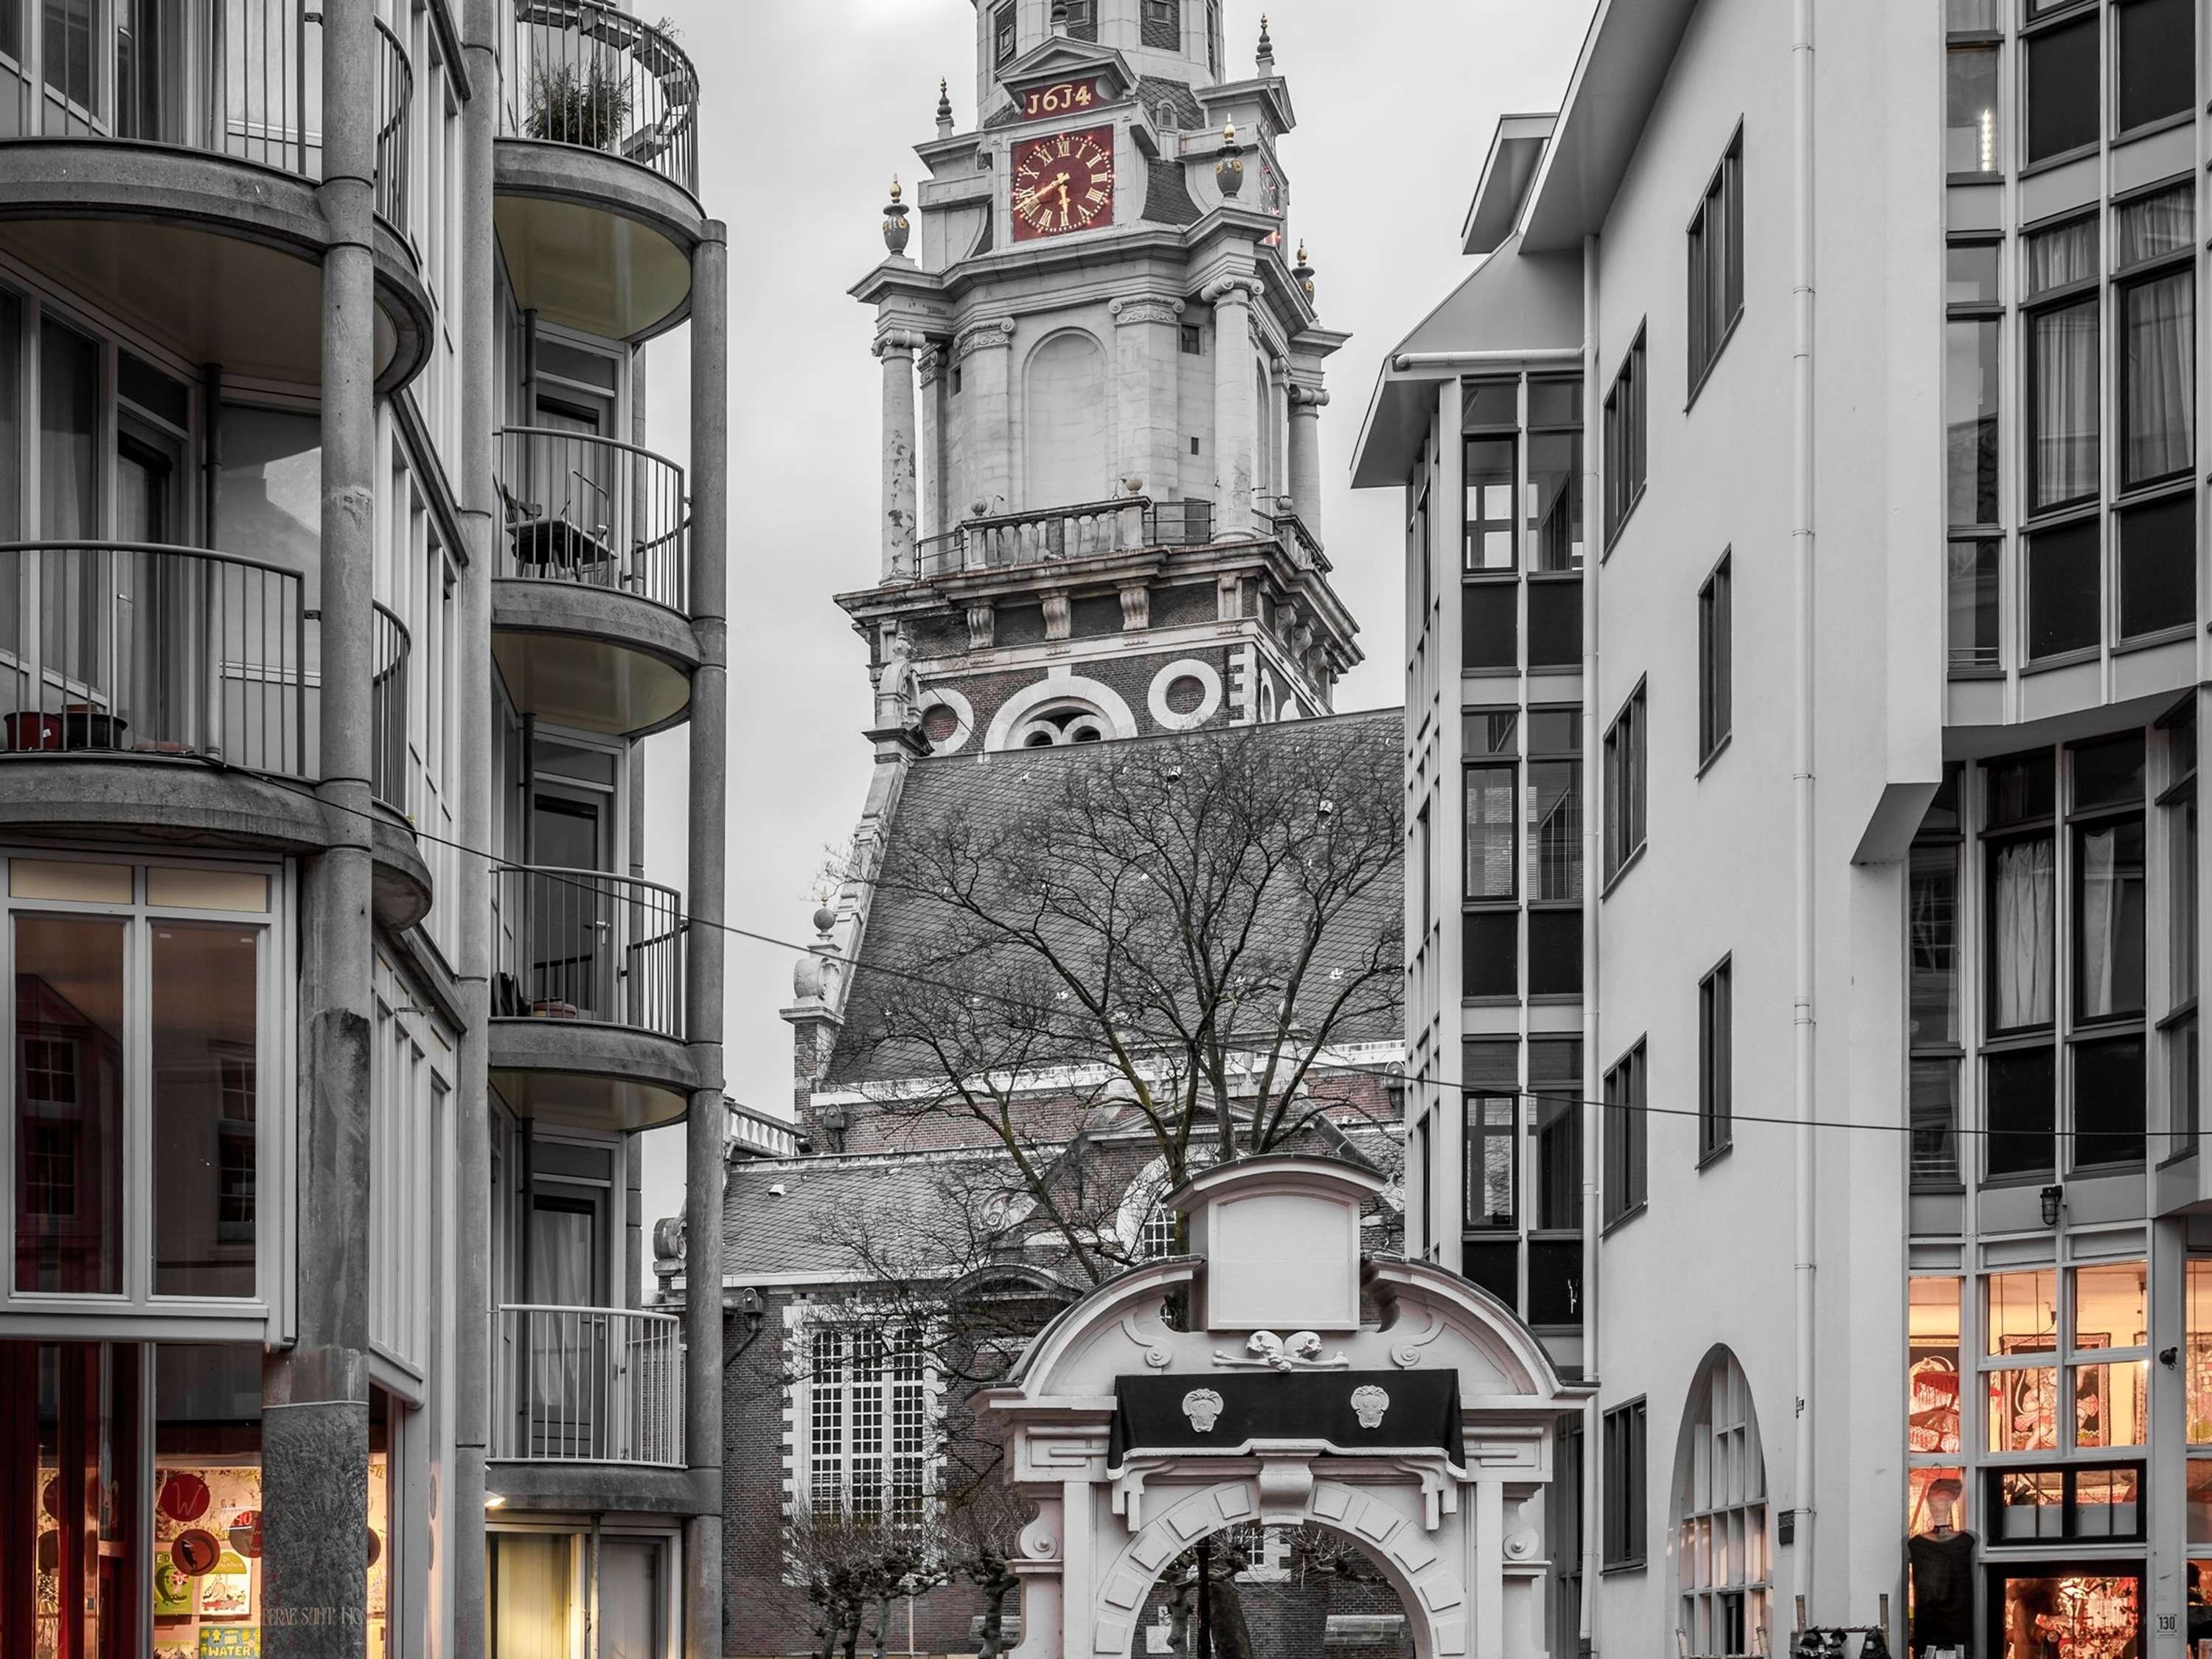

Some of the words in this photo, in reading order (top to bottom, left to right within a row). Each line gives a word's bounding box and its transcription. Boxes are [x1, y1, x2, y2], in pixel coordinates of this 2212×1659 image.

[1057, 141, 1071, 158] XII
[1086, 153, 1102, 169] II
[1023, 167, 1040, 180] X
[1091, 171, 1107, 184] III
[2159, 1616, 2175, 1630] 130
[208, 1646, 251, 1656] WATER
